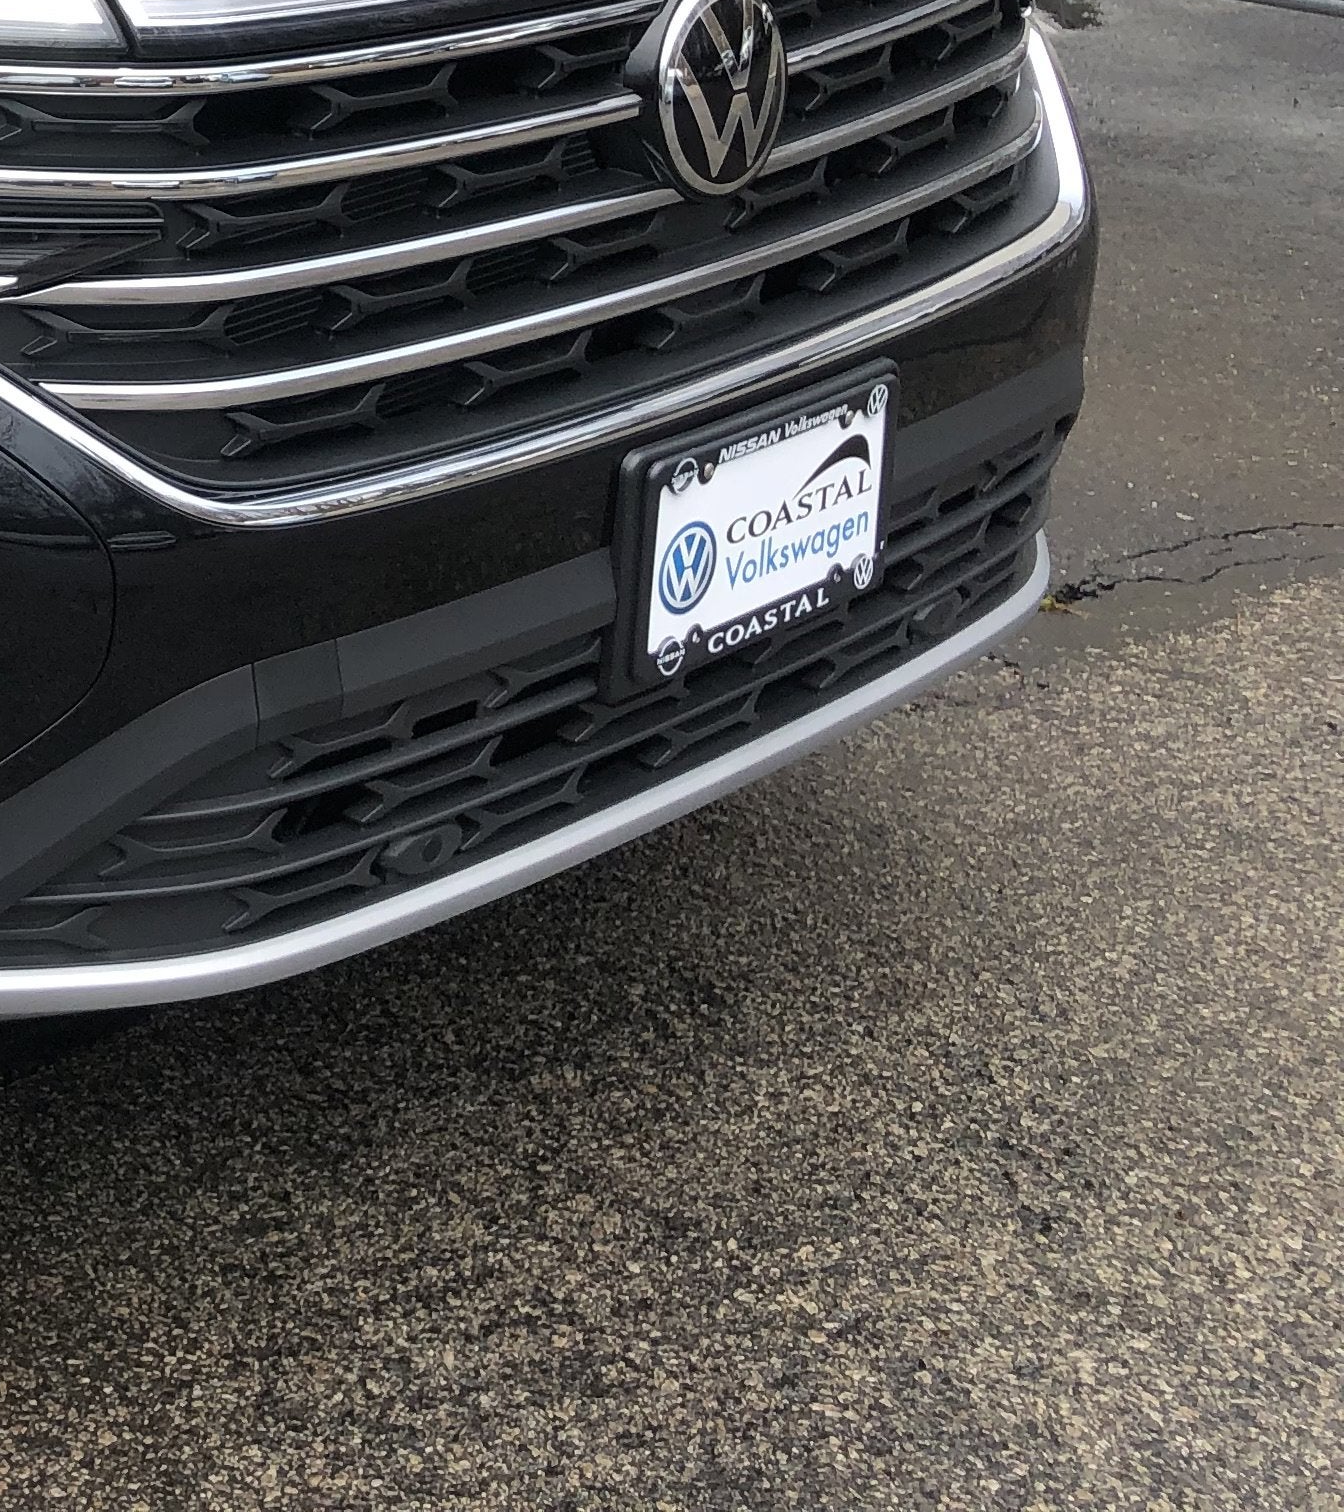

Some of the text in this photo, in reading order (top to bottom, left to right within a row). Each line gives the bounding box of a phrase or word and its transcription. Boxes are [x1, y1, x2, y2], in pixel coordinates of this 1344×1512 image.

[718, 403, 848, 464] NISSAN Volkswagen
[726, 468, 873, 545] COASTAL
[725, 510, 869, 590] Volkswagen
[707, 587, 829, 654] COASTAL
